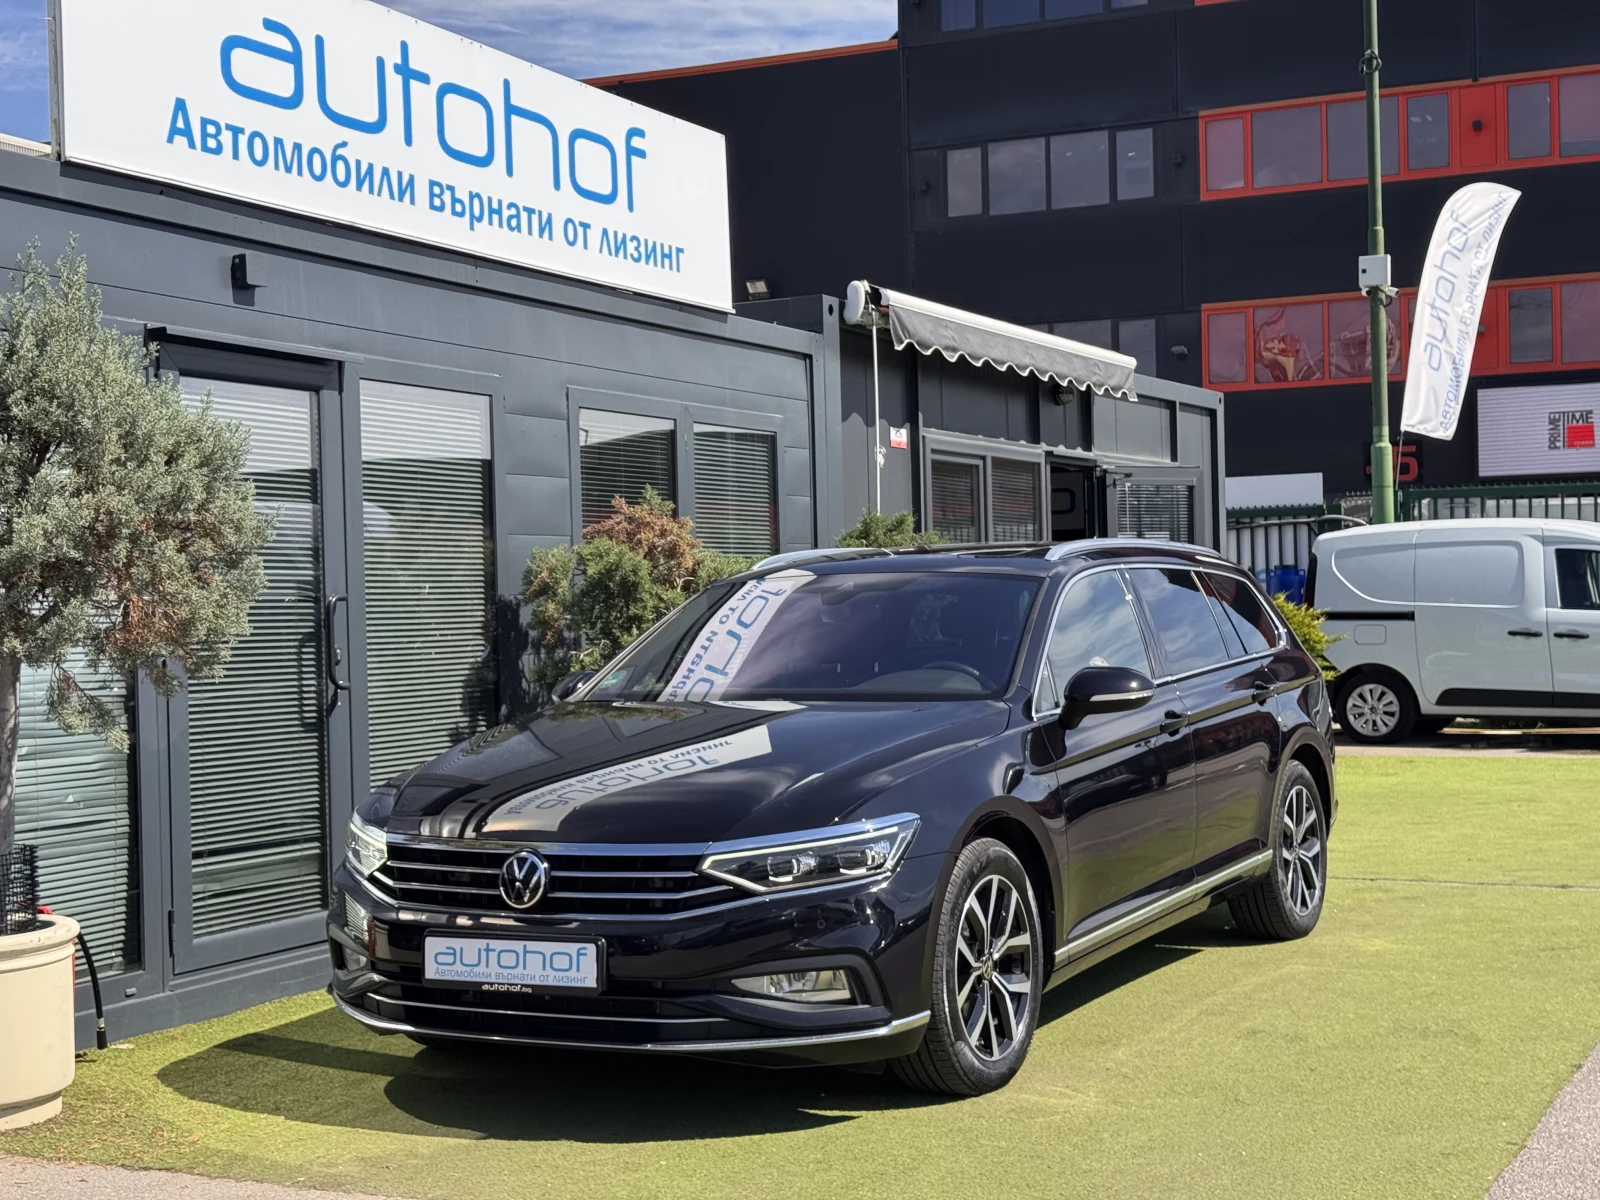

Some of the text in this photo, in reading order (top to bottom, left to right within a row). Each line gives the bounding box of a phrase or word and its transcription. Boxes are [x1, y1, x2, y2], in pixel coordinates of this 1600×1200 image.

[219, 16, 647, 214] autohof
[166, 96, 686, 273] Автомобили върнати от лизинг
[1423, 209, 1473, 372] autohof
[1548, 412, 1561, 449] PRIME
[434, 942, 588, 973] autohof
[434, 966, 588, 985] Автомобили върнати от лизинг
[481, 983, 533, 993] autohof.bg
